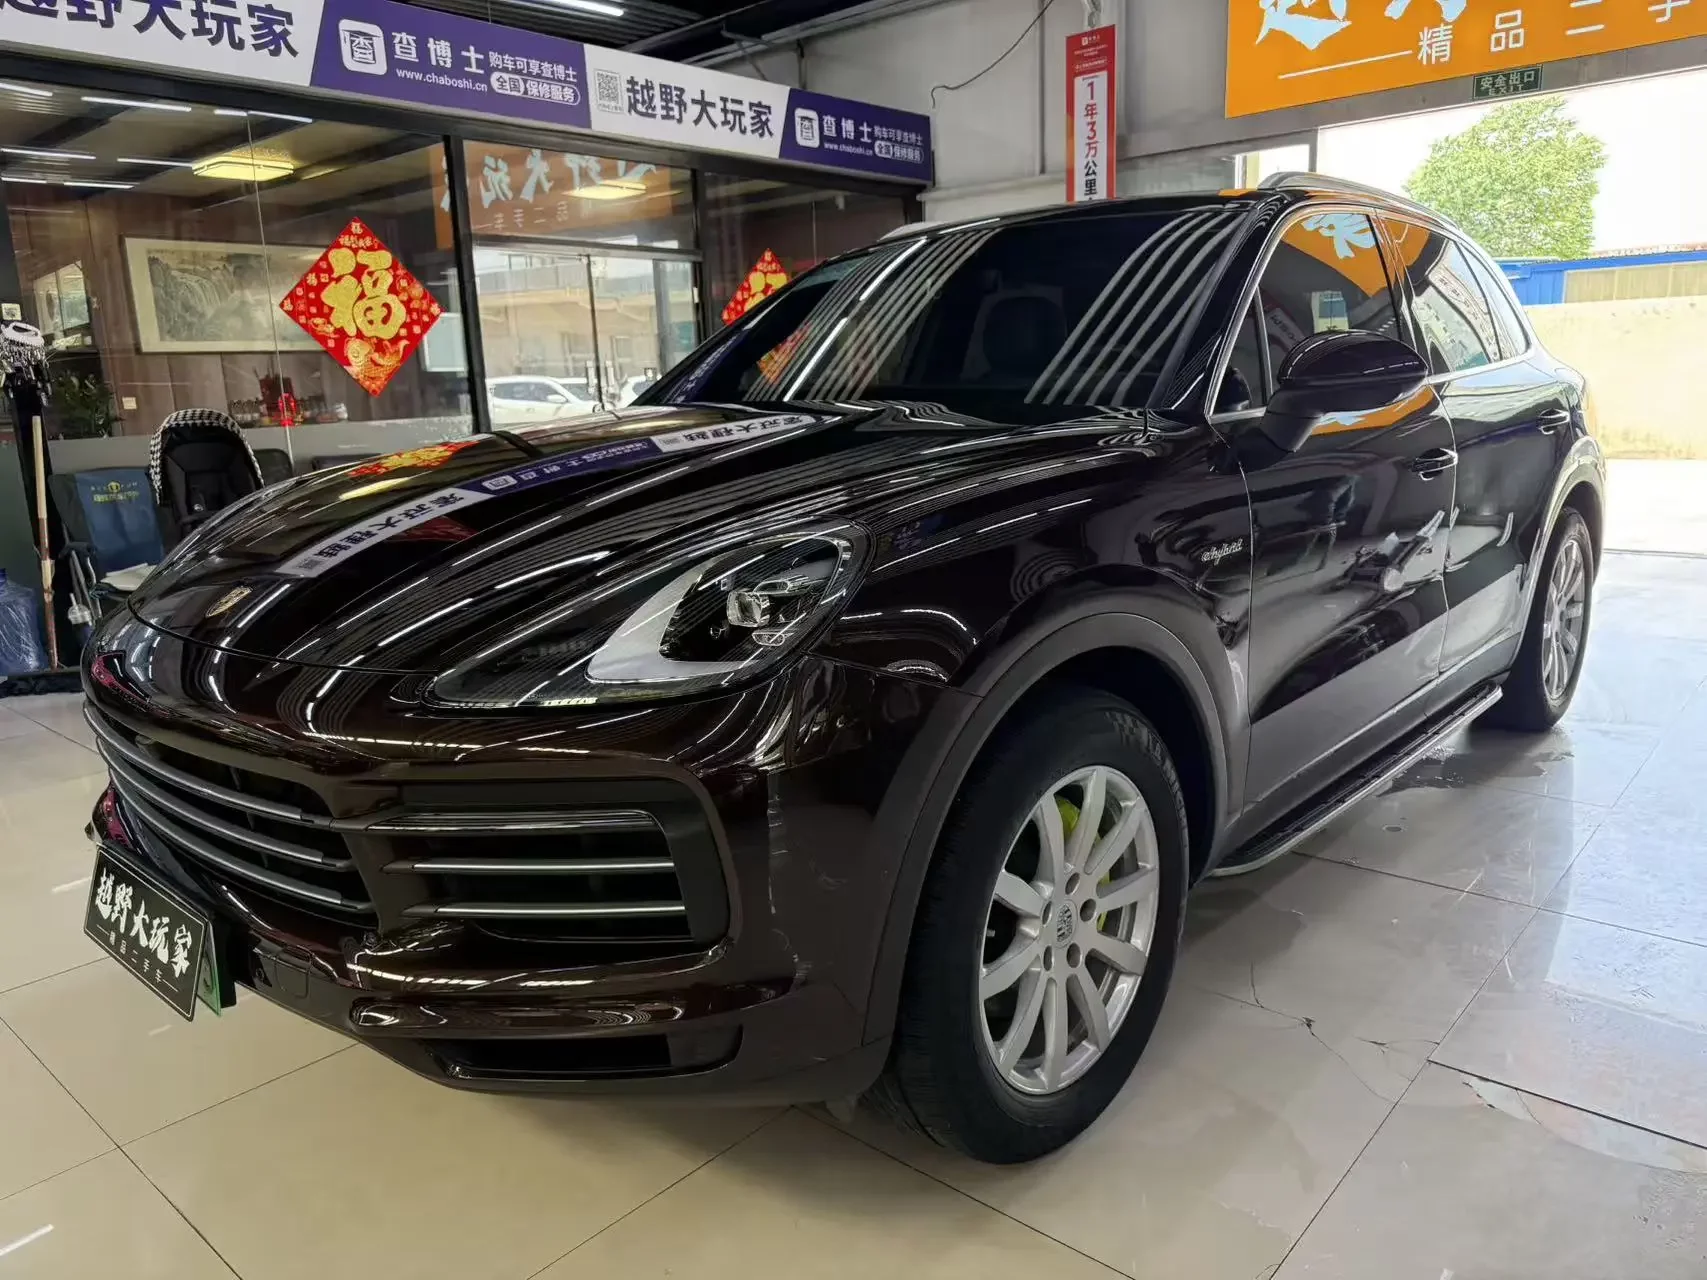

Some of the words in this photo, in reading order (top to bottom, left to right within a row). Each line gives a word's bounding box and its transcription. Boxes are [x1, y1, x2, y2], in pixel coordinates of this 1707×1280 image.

[391, 32, 485, 75] 查博士
[488, 51, 578, 83] 购车可享查博士
[395, 68, 488, 93] www.chaboshi.cn
[1480, 71, 1535, 90] 安全出口
[1488, 84, 1524, 97] EXIT
[626, 75, 774, 138] 越野大玩家
[822, 114, 873, 143] 查博士
[1083, 80, 1099, 200] 1年3万公里
[320, 247, 407, 341] 福
[95, 867, 193, 978] 越野大玩家
